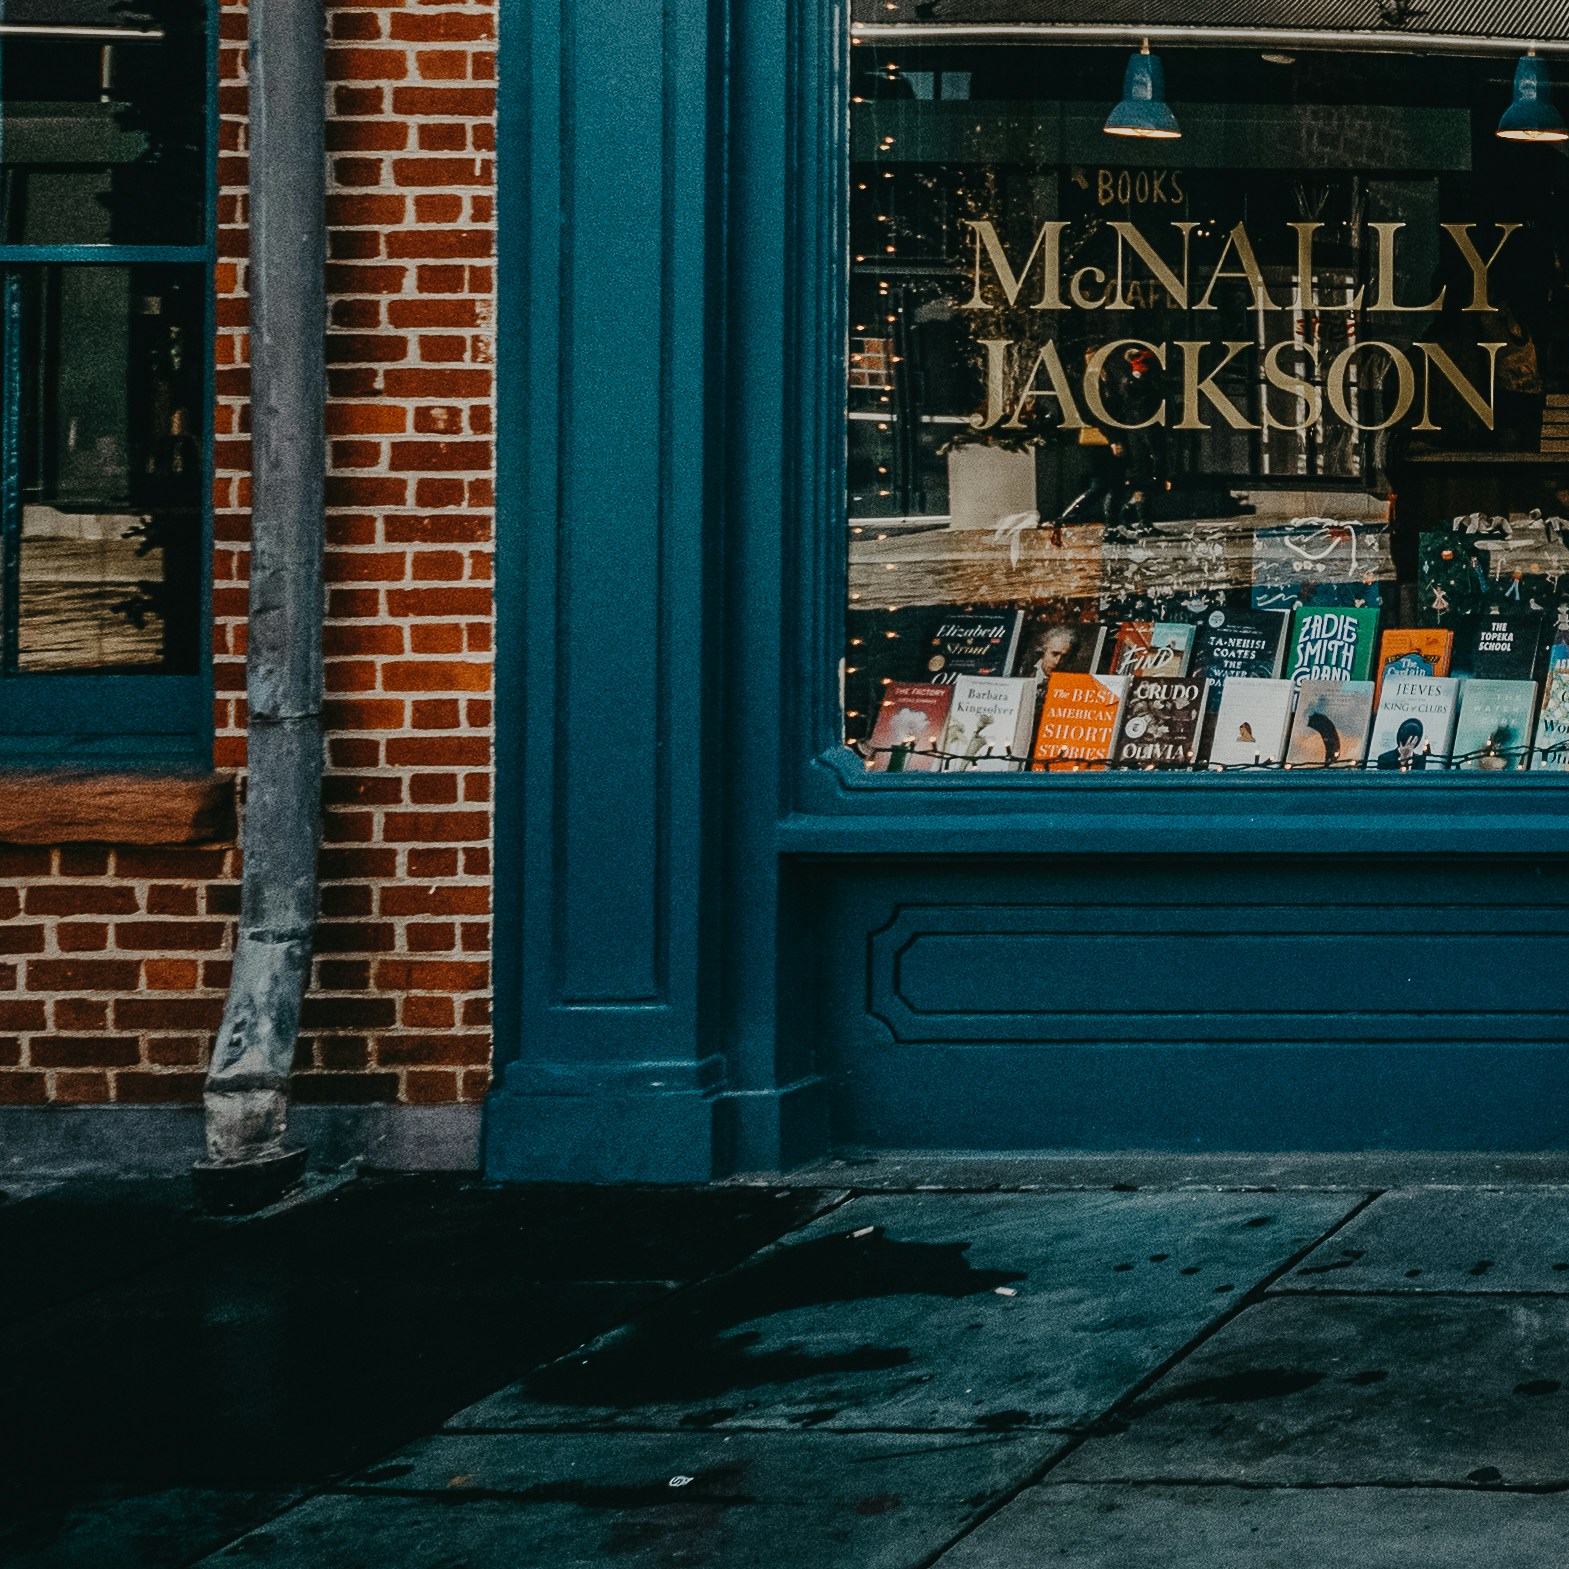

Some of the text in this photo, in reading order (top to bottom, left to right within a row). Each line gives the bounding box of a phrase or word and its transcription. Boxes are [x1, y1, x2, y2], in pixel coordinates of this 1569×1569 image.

[1097, 168, 1185, 206] BOOKS
[961, 220, 1523, 313] McNALLY
[968, 338, 1508, 432] JACKSON
[936, 623, 1007, 638] Elizabeth
[1299, 613, 1358, 643] ZADIE
[1491, 622, 1508, 632] THE
[1480, 632, 1514, 642] TOPEKA
[1213, 647, 1257, 660] COATES
[1478, 641, 1512, 652] SCHOOL
[1294, 640, 1356, 670] SMITH
[1223, 659, 1243, 669] THE
[968, 688, 1009, 701] Barbara
[1053, 688, 1121, 706] The BEST
[1134, 679, 1200, 702] CRUDO
[1396, 683, 1442, 696] JEEVES
[956, 702, 1014, 715] Kingsolver
[1046, 706, 1115, 722] AMERICAN
[1383, 702, 1410, 713] KING
[1418, 703, 1449, 714] CLUBS
[1042, 723, 1113, 744] SHORT
[1037, 742, 1107, 761] STORIES
[1121, 742, 1185, 760] OLIVIA
